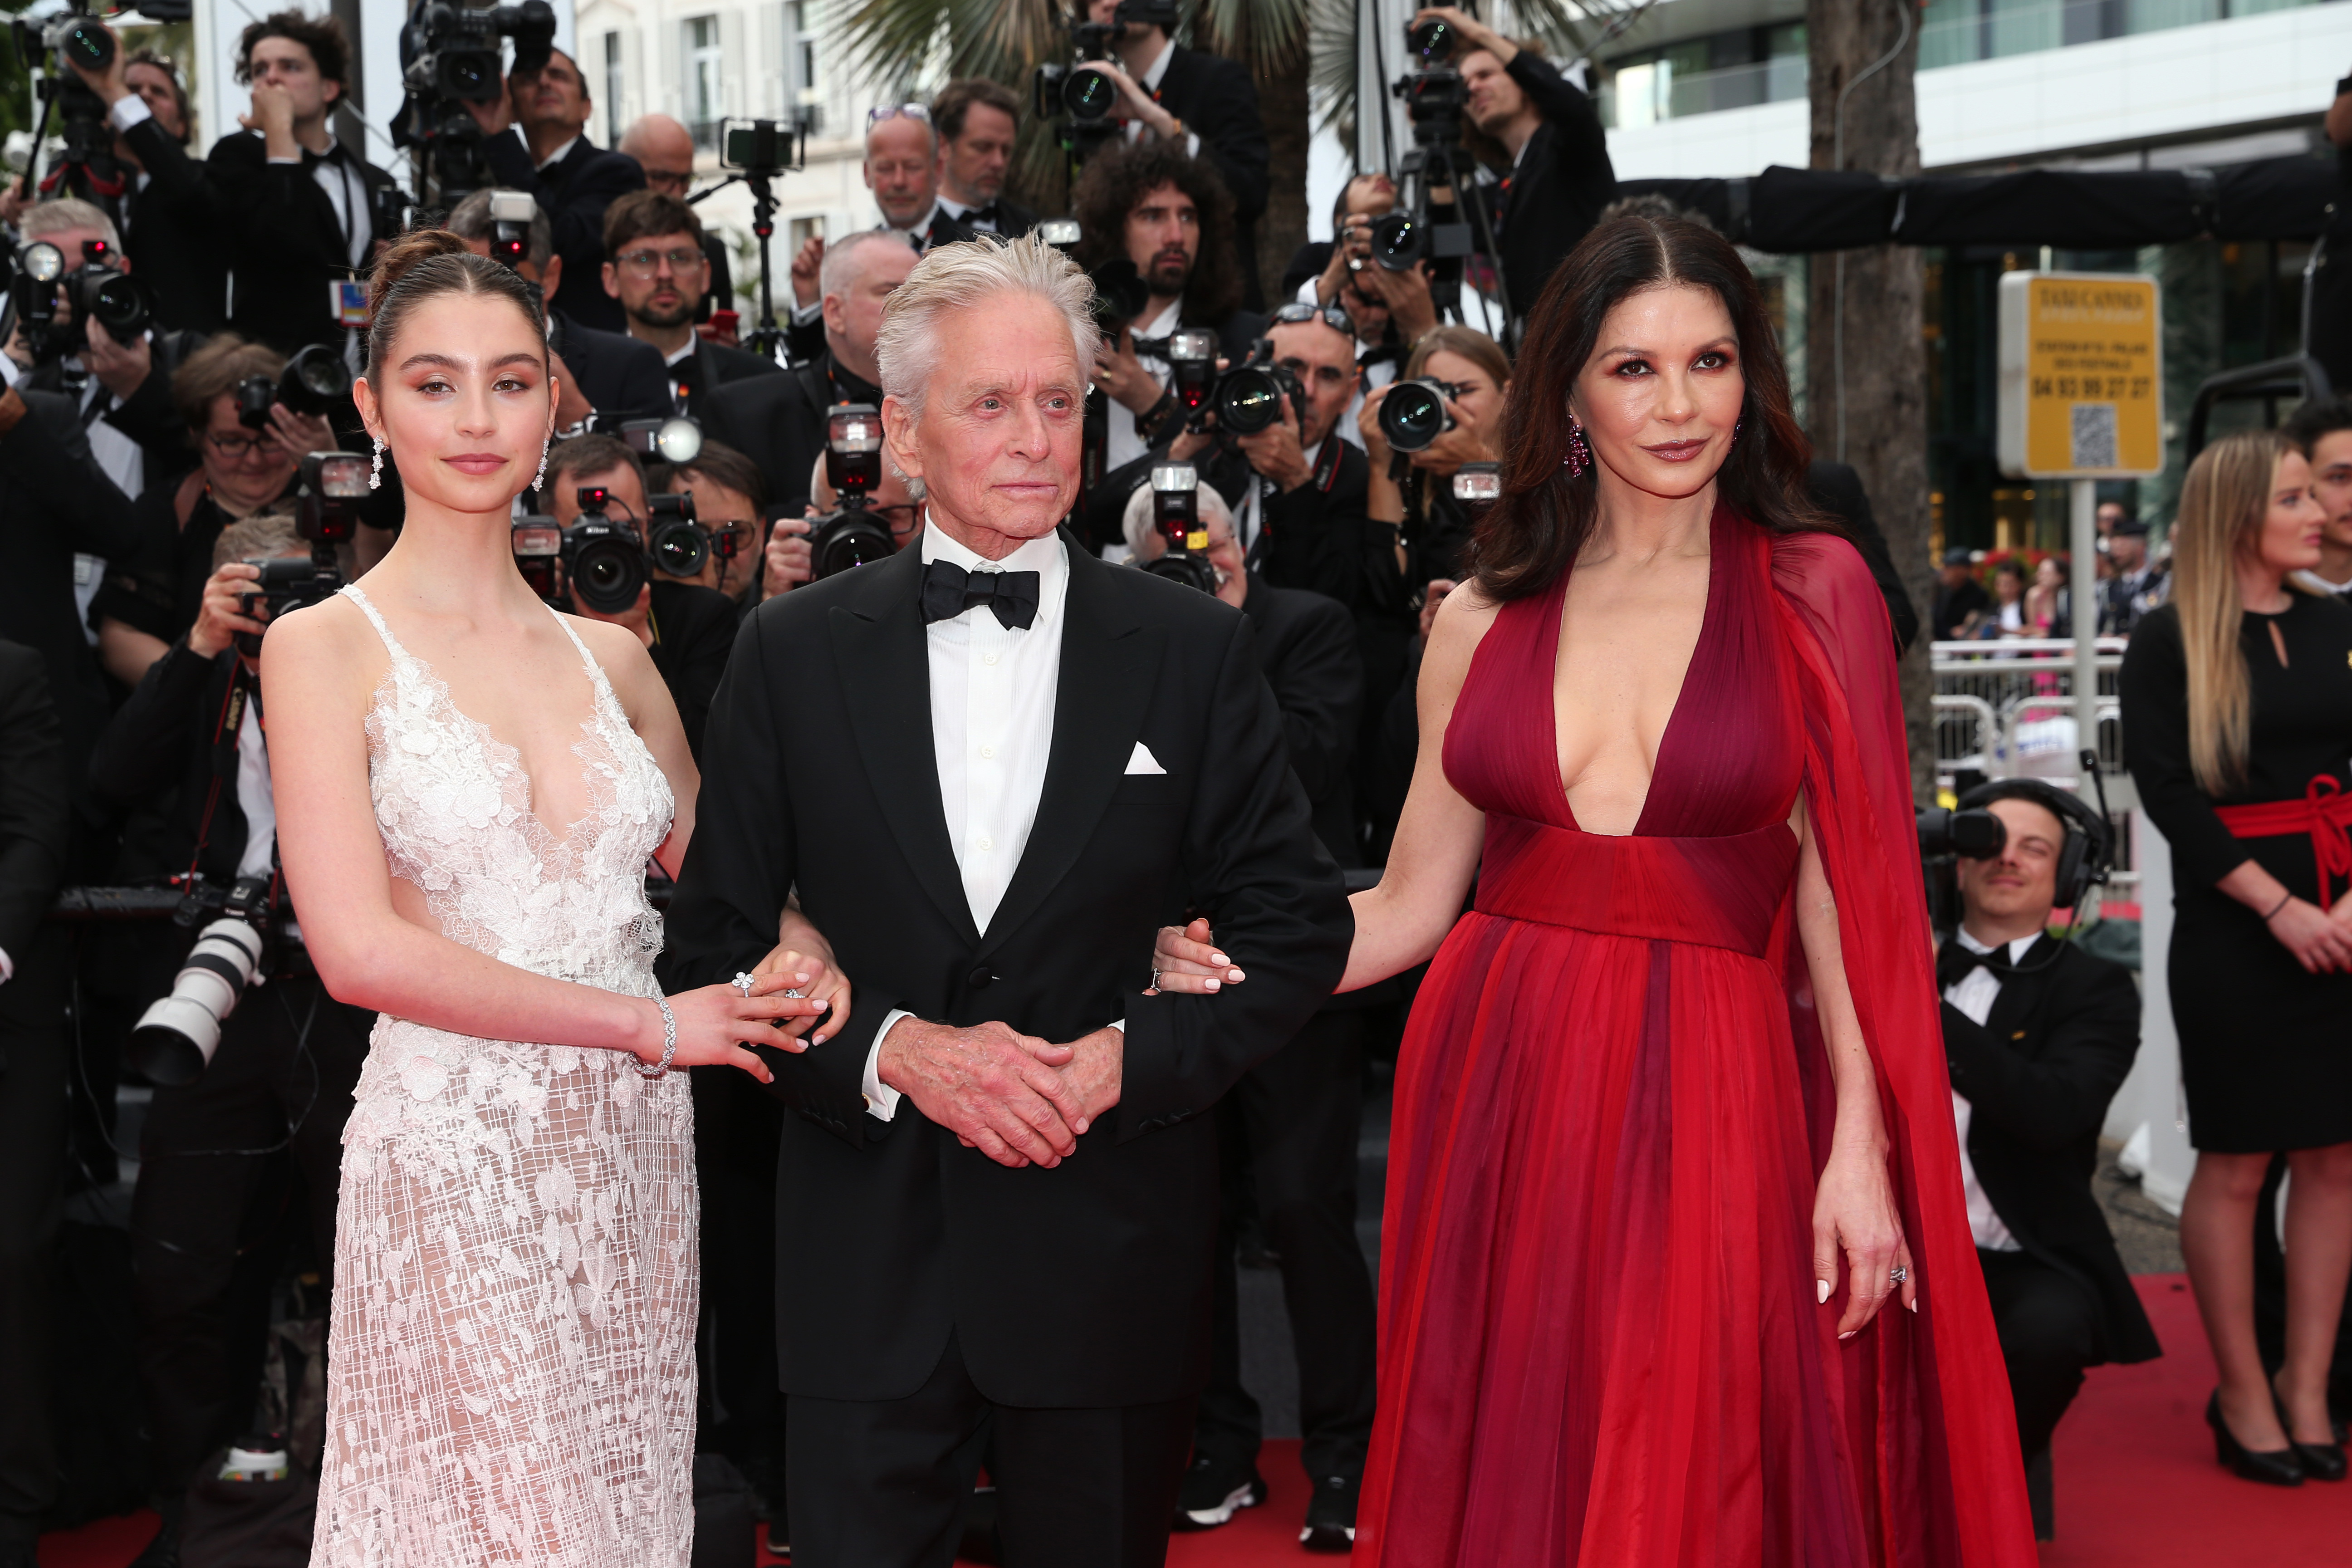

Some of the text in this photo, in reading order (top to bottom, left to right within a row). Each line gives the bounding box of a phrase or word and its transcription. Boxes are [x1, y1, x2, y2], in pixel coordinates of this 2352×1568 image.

[2039, 287, 2144, 310] TAXI CANNES
[2033, 376, 2151, 398] 04 93 99 27 27
